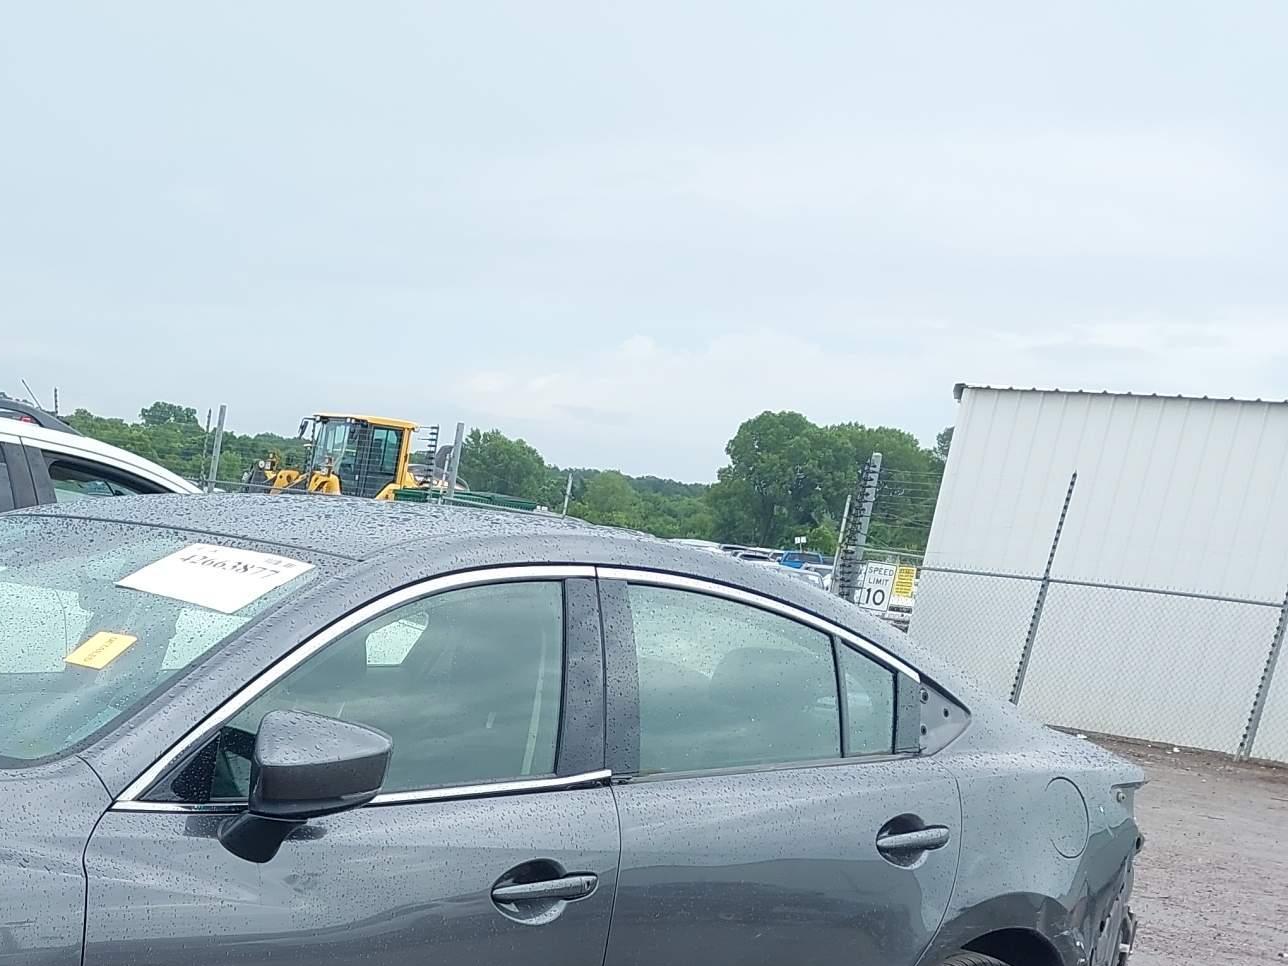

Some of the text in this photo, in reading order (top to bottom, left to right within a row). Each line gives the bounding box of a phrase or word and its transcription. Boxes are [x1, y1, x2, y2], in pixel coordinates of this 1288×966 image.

[867, 566, 894, 576] SPEED
[868, 577, 890, 587] LIMIT
[864, 587, 886, 606] 10
